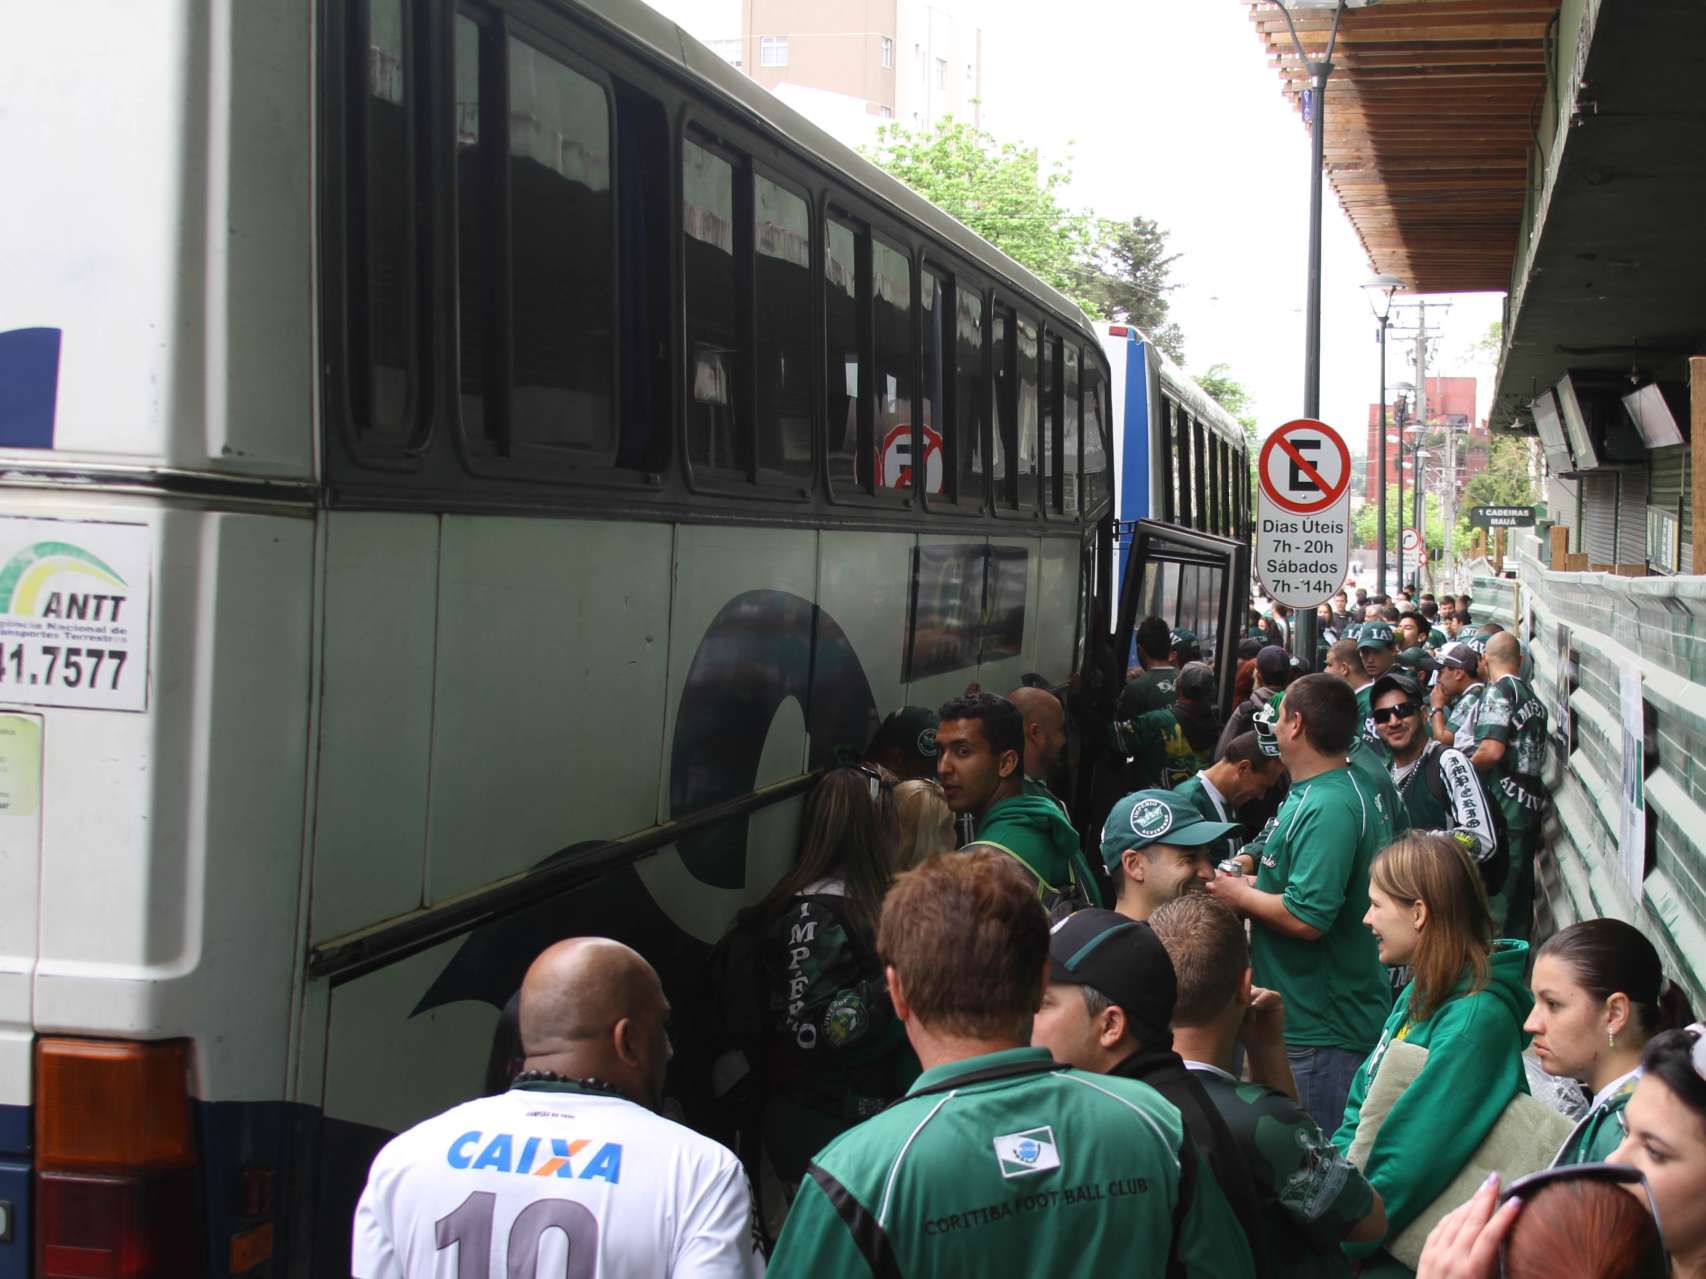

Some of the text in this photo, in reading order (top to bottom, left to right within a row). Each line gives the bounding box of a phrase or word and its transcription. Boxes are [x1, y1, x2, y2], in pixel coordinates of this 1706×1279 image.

[1263, 517, 1344, 534] Dias Úteis
[1266, 559, 1338, 574] Sábados
[43, 591, 127, 622] ANTT
[447, 1131, 624, 1185] CAIXA
[923, 1202, 1012, 1236] CORITIBA
[1108, 1177, 1149, 1197] CLUB
